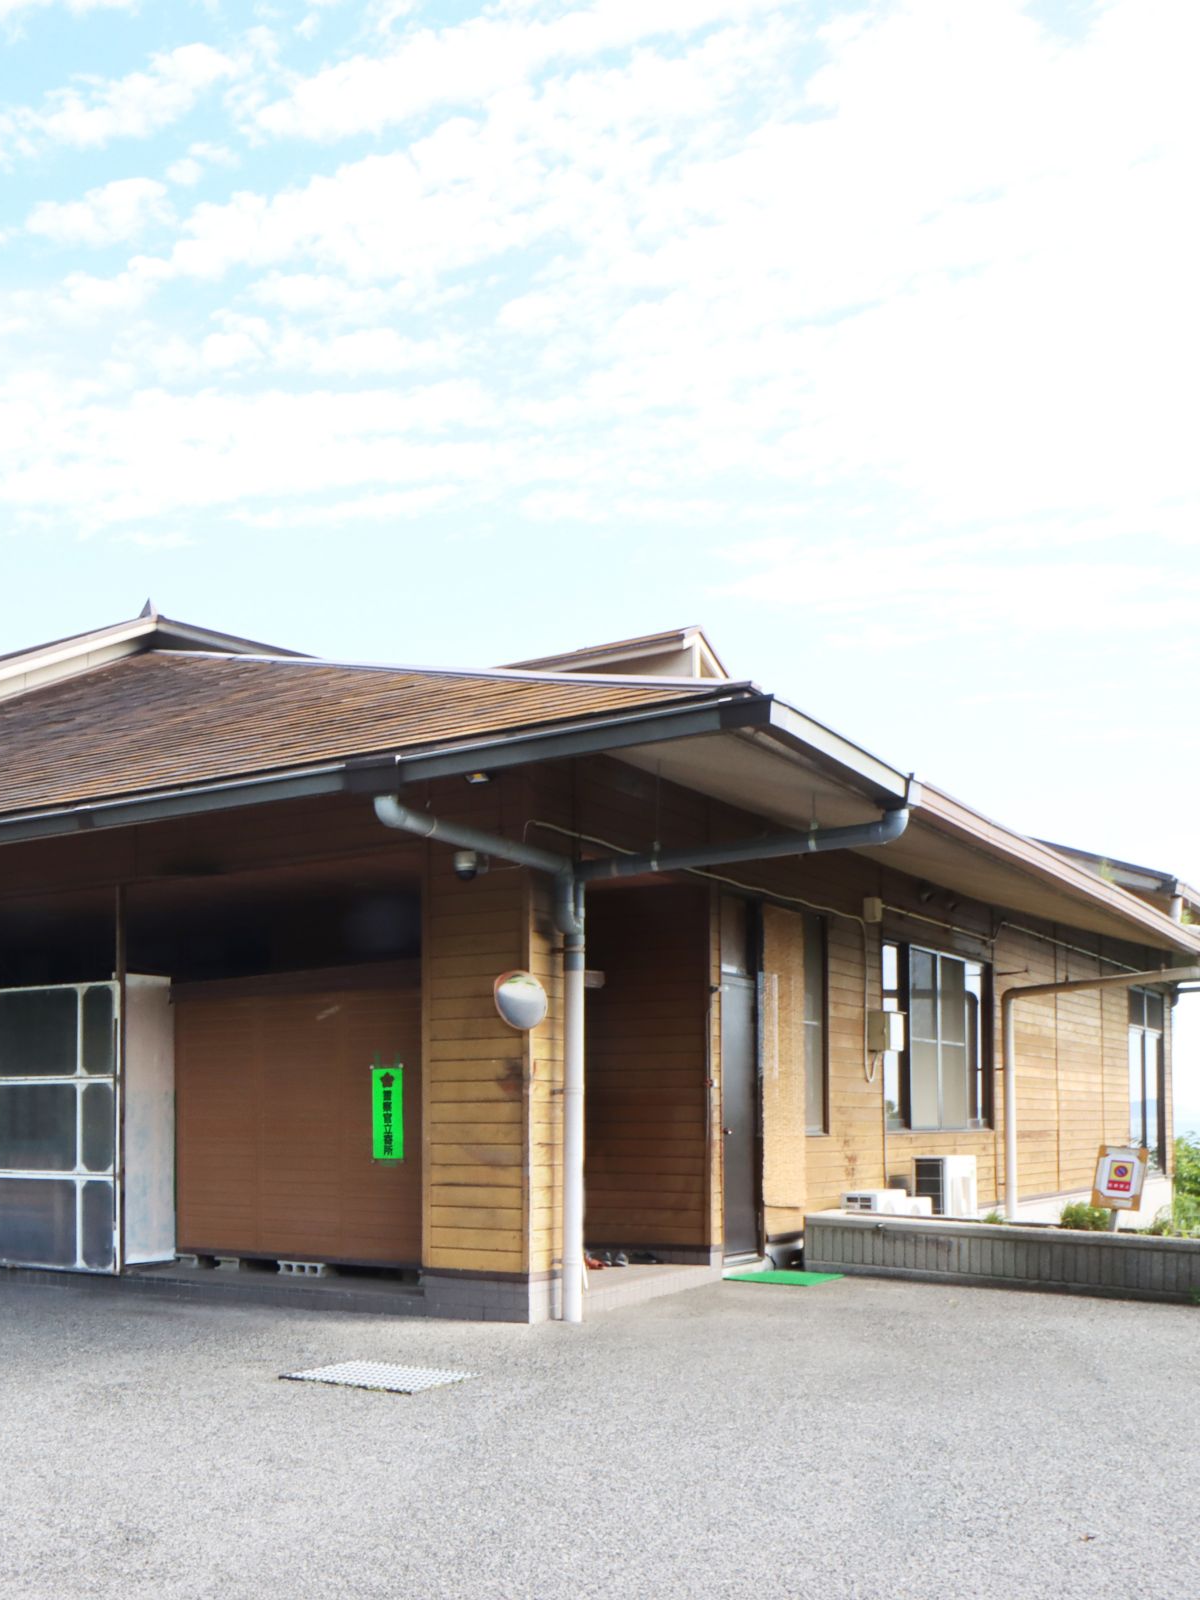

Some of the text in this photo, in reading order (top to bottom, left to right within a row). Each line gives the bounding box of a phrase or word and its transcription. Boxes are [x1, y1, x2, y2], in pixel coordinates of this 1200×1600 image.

[383, 1090, 393, 1156] 警察官立寄所
